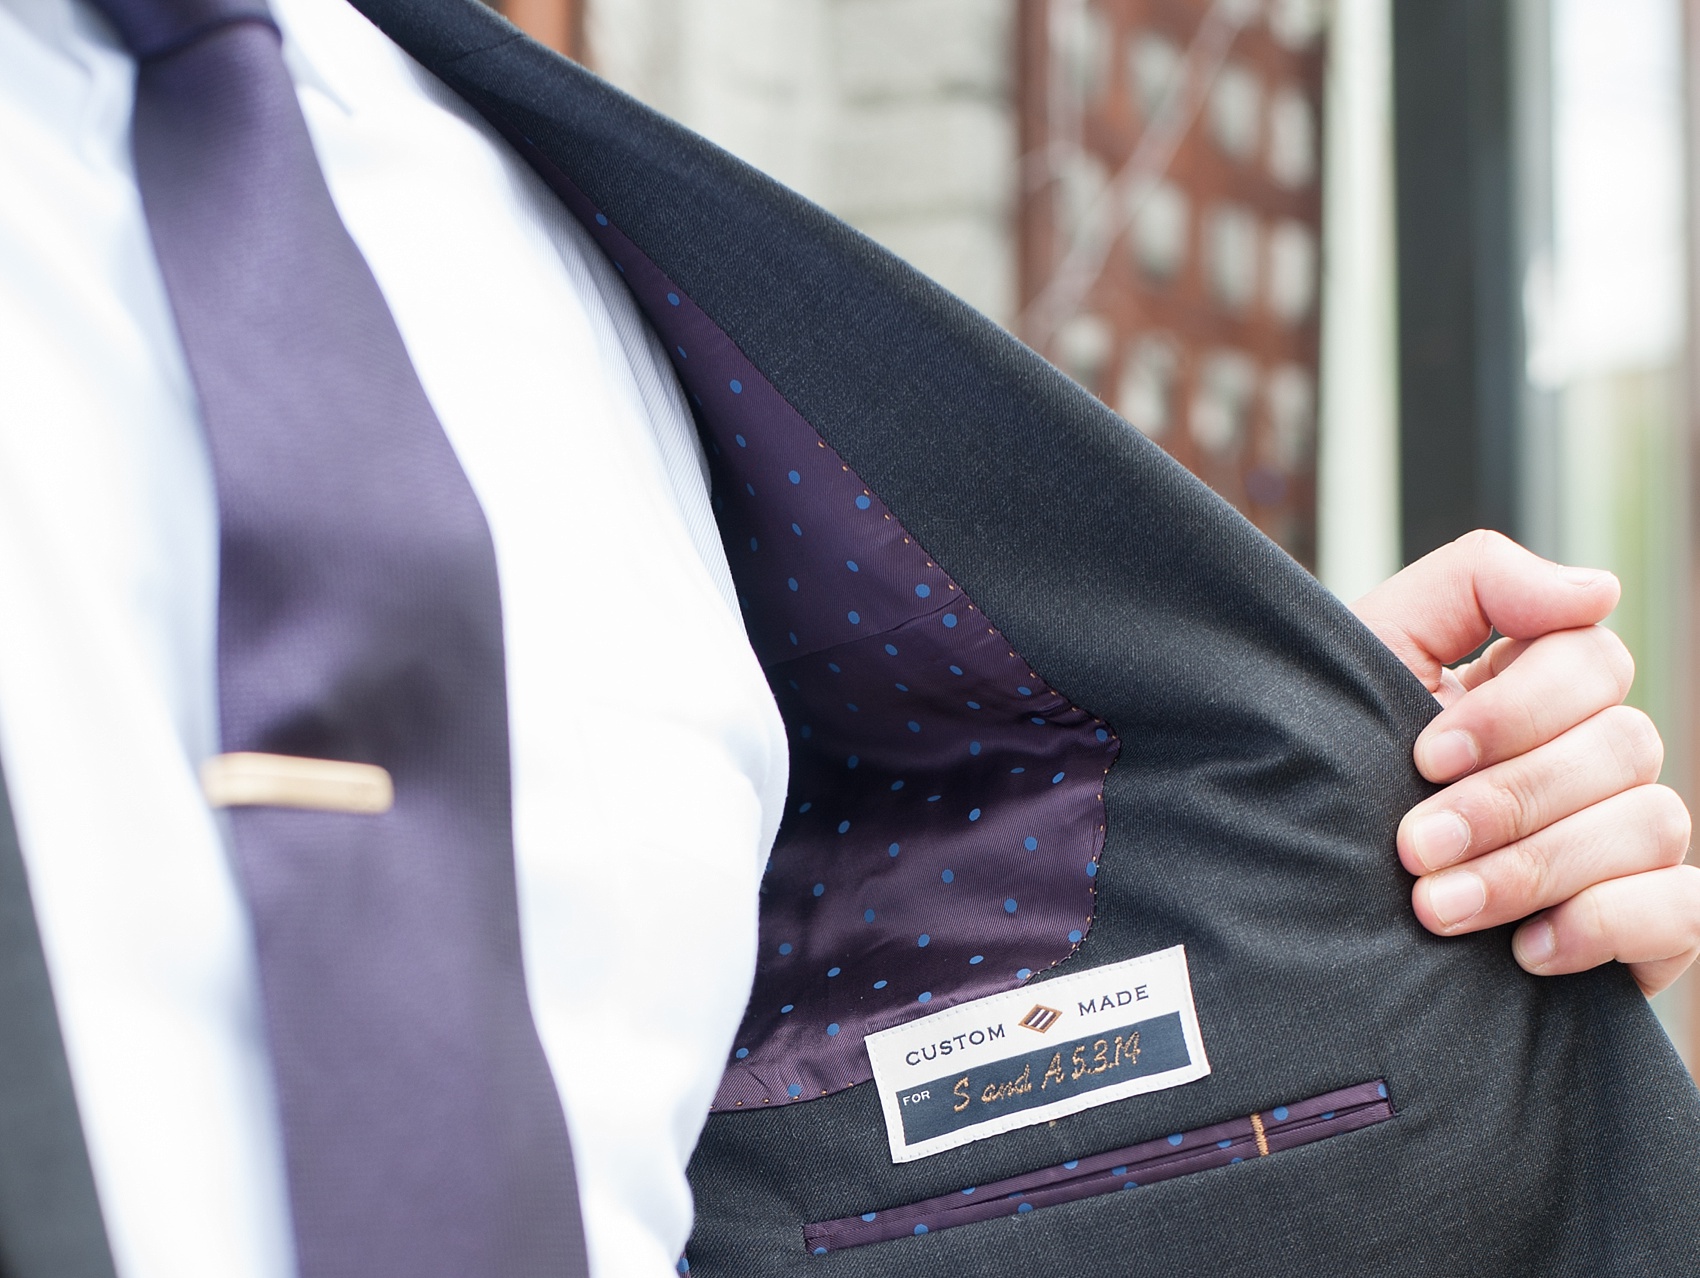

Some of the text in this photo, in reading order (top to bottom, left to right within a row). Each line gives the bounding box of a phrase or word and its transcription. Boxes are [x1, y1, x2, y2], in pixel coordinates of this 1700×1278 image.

[905, 984, 1149, 1066] CUSTOM MADE
[902, 1090, 931, 1106] FOR
[953, 1076, 971, 1112] S
[981, 1063, 1033, 1103] and
